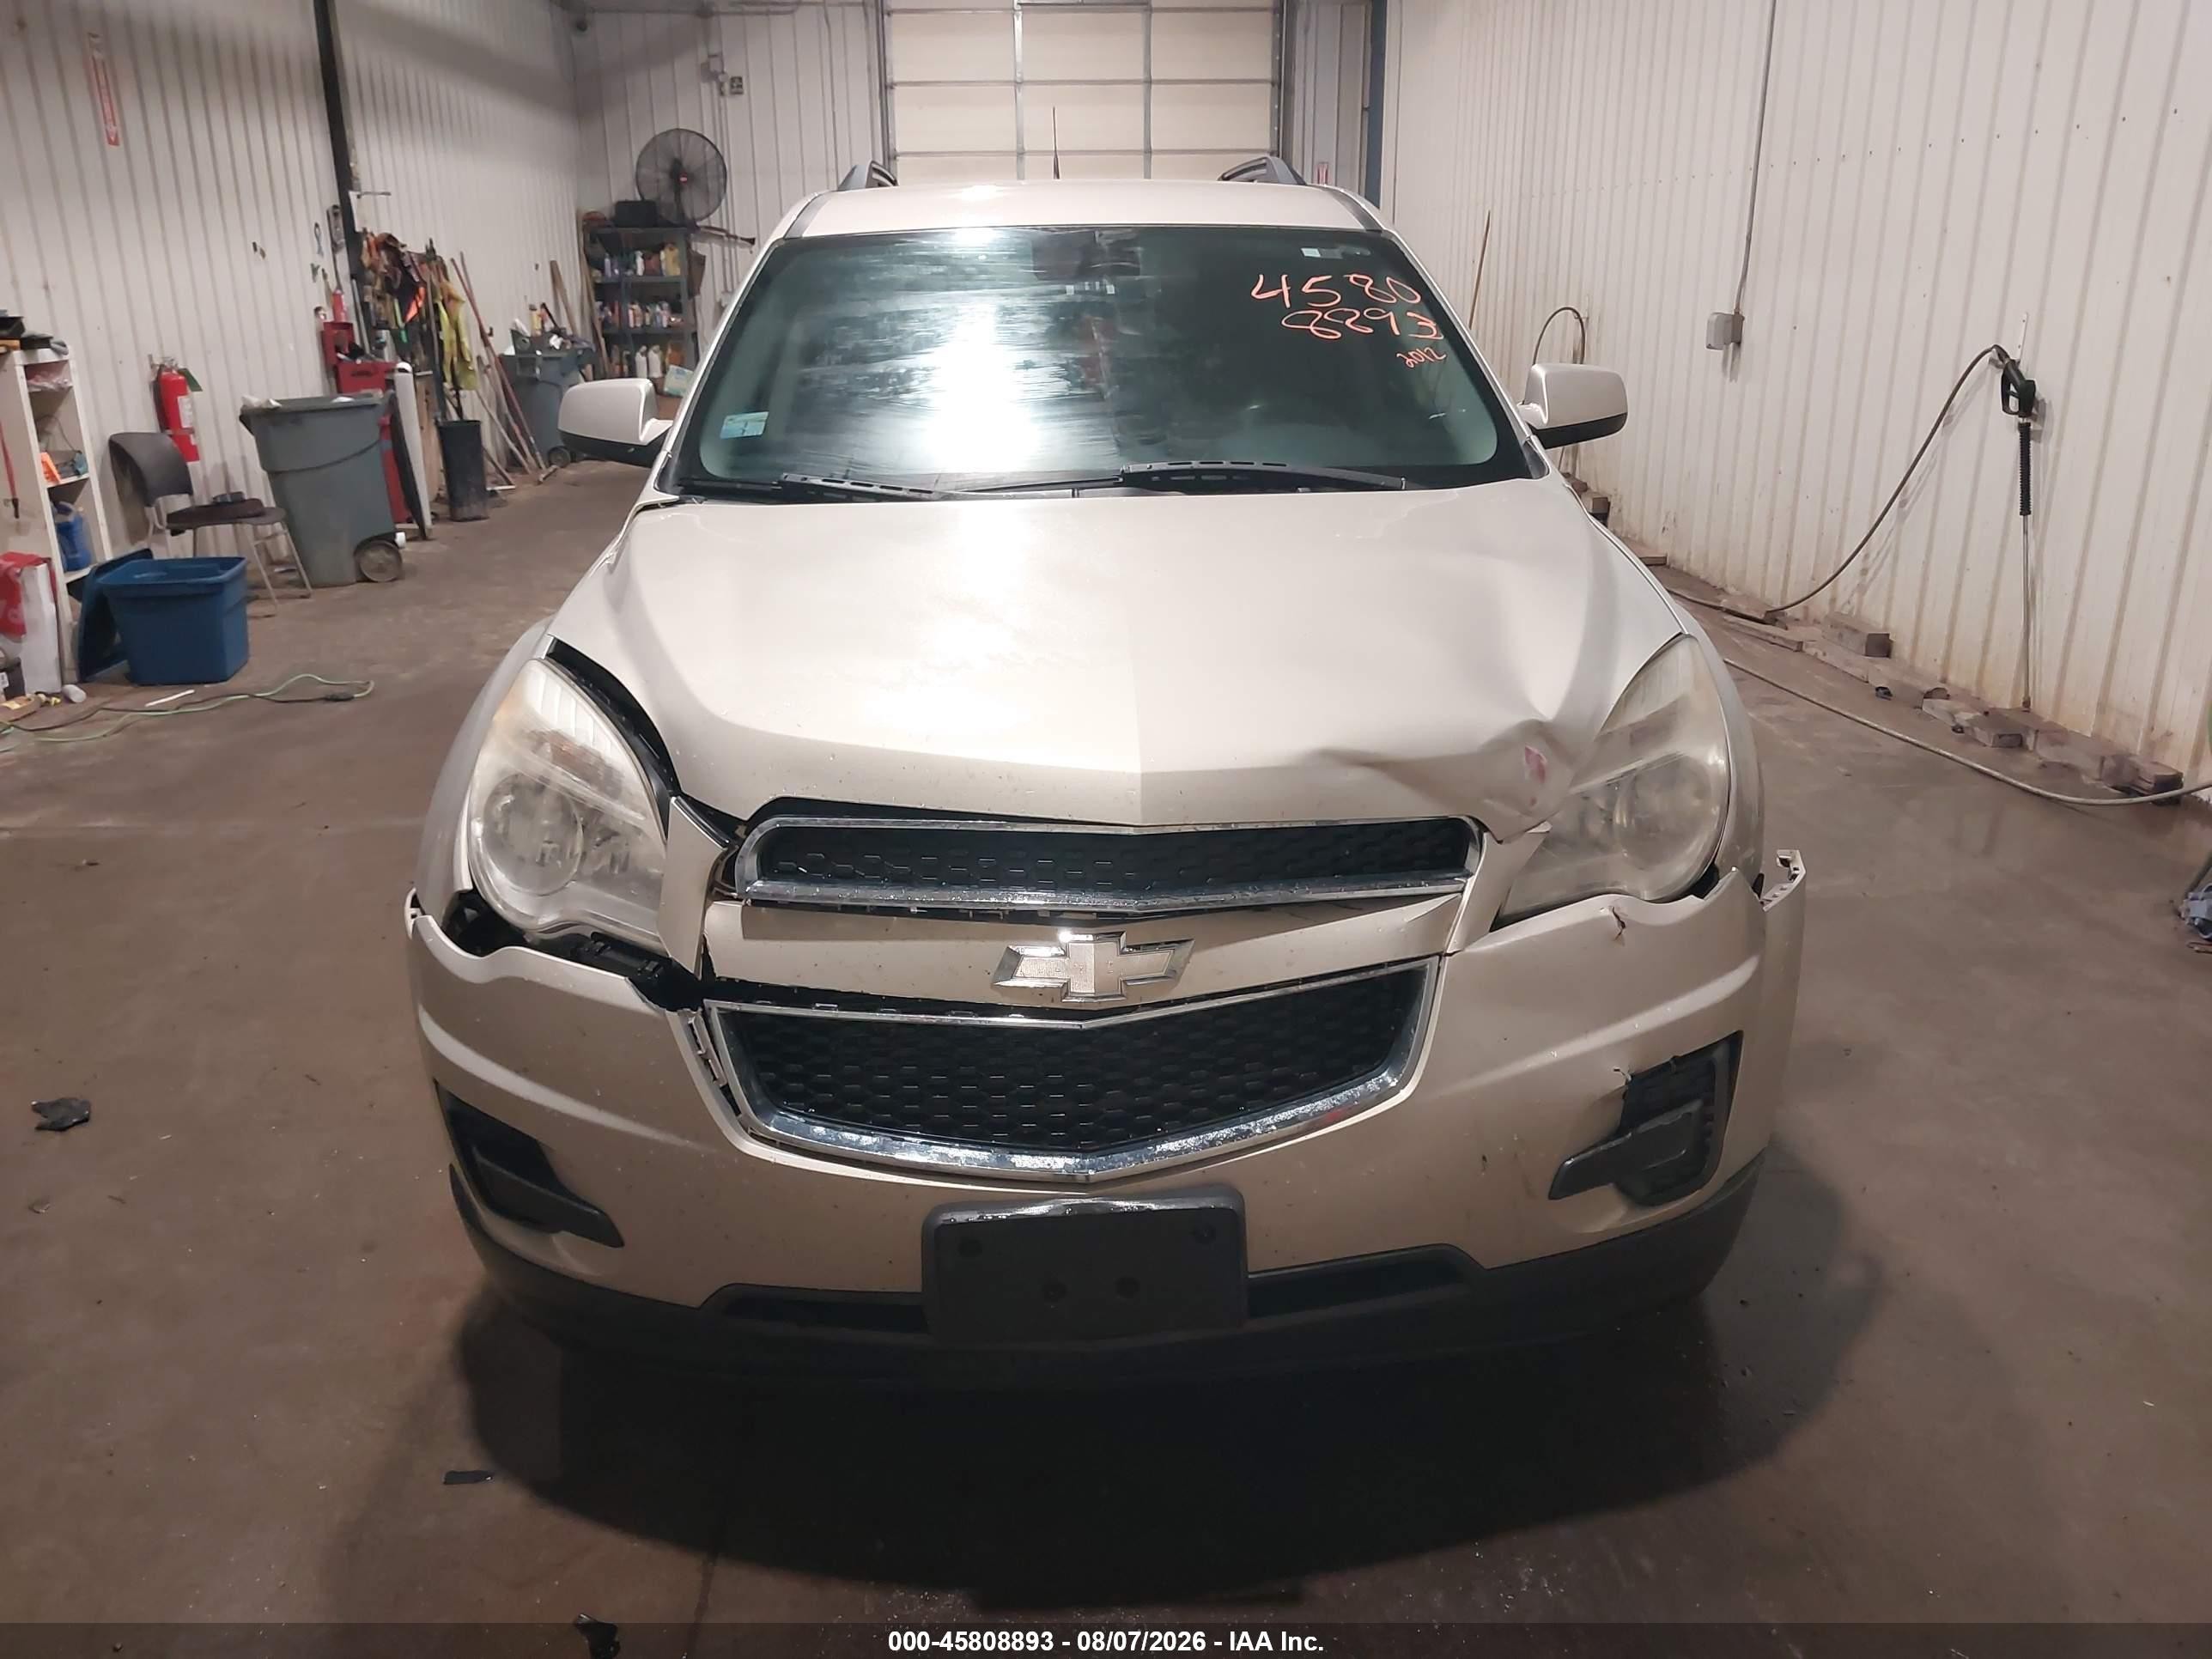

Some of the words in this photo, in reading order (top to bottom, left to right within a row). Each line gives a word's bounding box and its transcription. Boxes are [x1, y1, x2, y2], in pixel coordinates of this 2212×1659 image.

[1250, 274, 1422, 308] 4580
[1281, 307, 1444, 340] 8893
[1396, 346, 1447, 368] 2012
